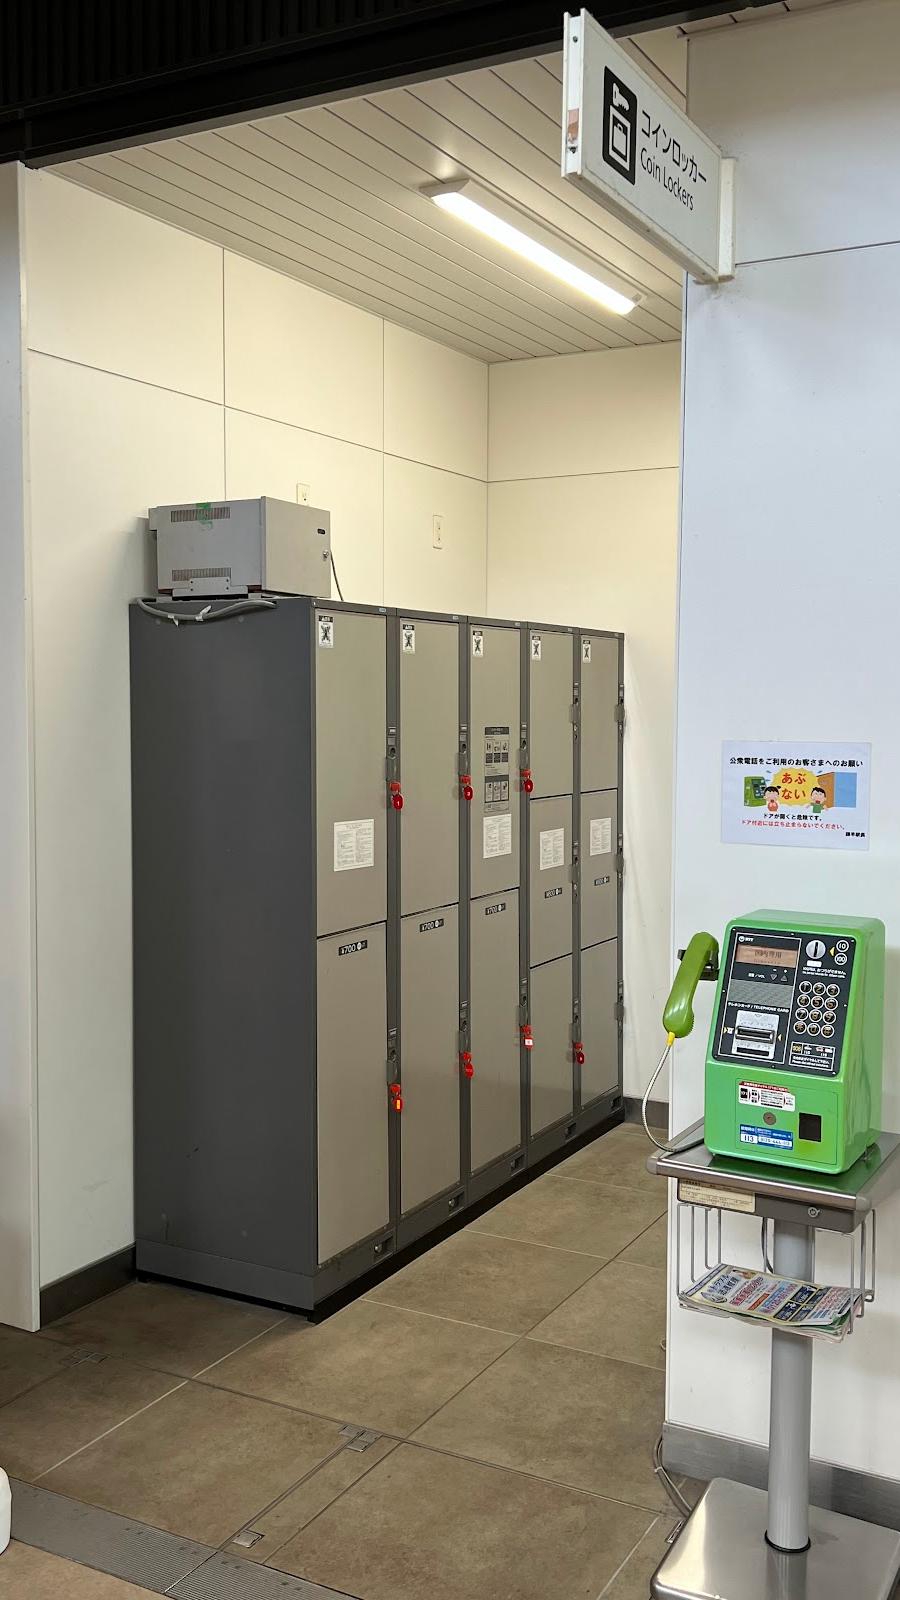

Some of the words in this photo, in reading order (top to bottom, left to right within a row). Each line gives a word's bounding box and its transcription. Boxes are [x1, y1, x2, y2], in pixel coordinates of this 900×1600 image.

[641, 110, 707, 183] コインロッカー
[640, 147, 661, 183] Coin
[663, 166, 694, 211] Lockers
[729, 757, 863, 768] 公衆電話をご利用のお客さまへのお願い
[781, 772, 806, 785] あぶ
[781, 788, 806, 800] ない
[341, 943, 356, 954] ¥700
